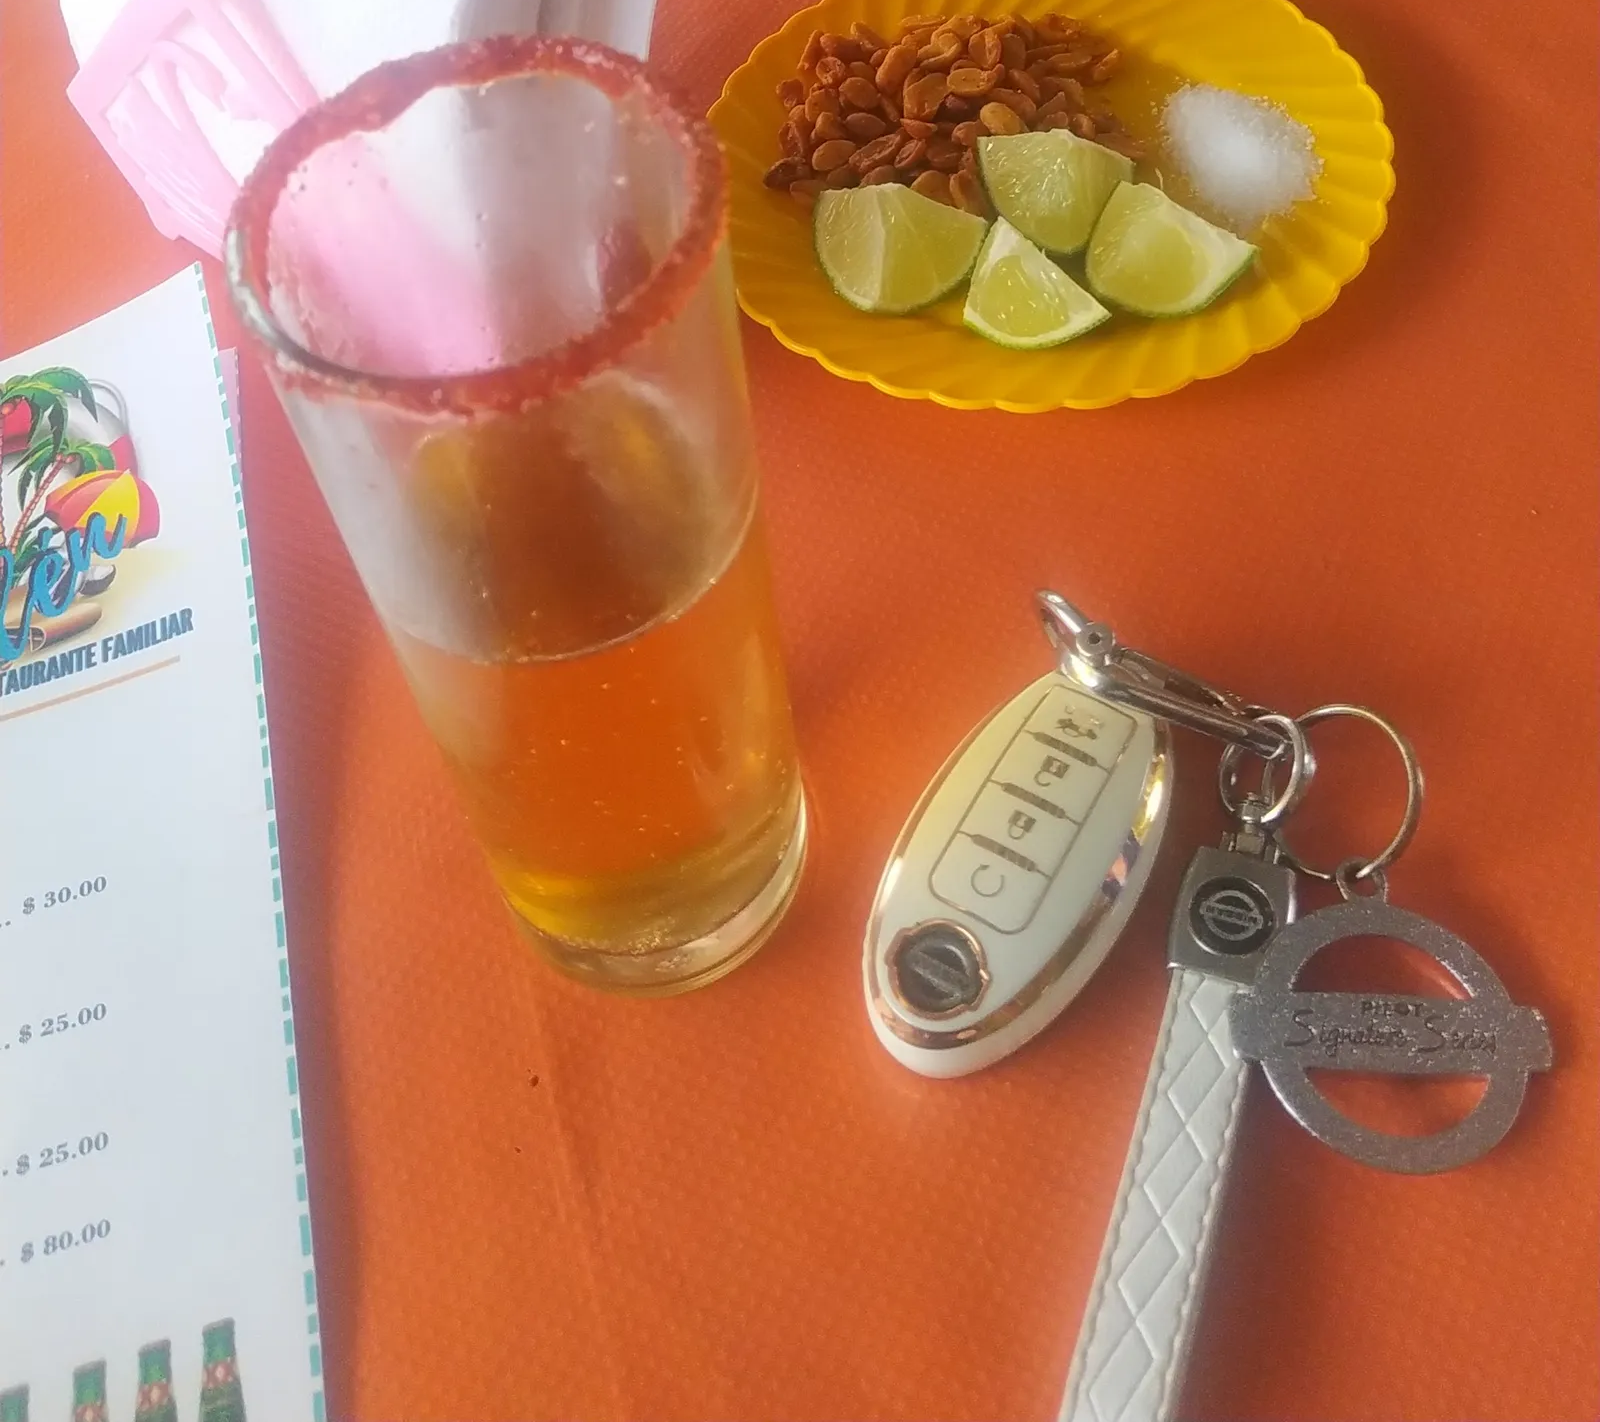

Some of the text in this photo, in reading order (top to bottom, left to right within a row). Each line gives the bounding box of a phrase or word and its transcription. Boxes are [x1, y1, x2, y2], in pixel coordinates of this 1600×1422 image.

[101, 607, 194, 663] FAMILIAR
[43, 876, 107, 909] 30.00
[40, 1002, 107, 1037] 25.00
[39, 1131, 110, 1169] 25.00
[43, 1218, 112, 1256] 80.00
